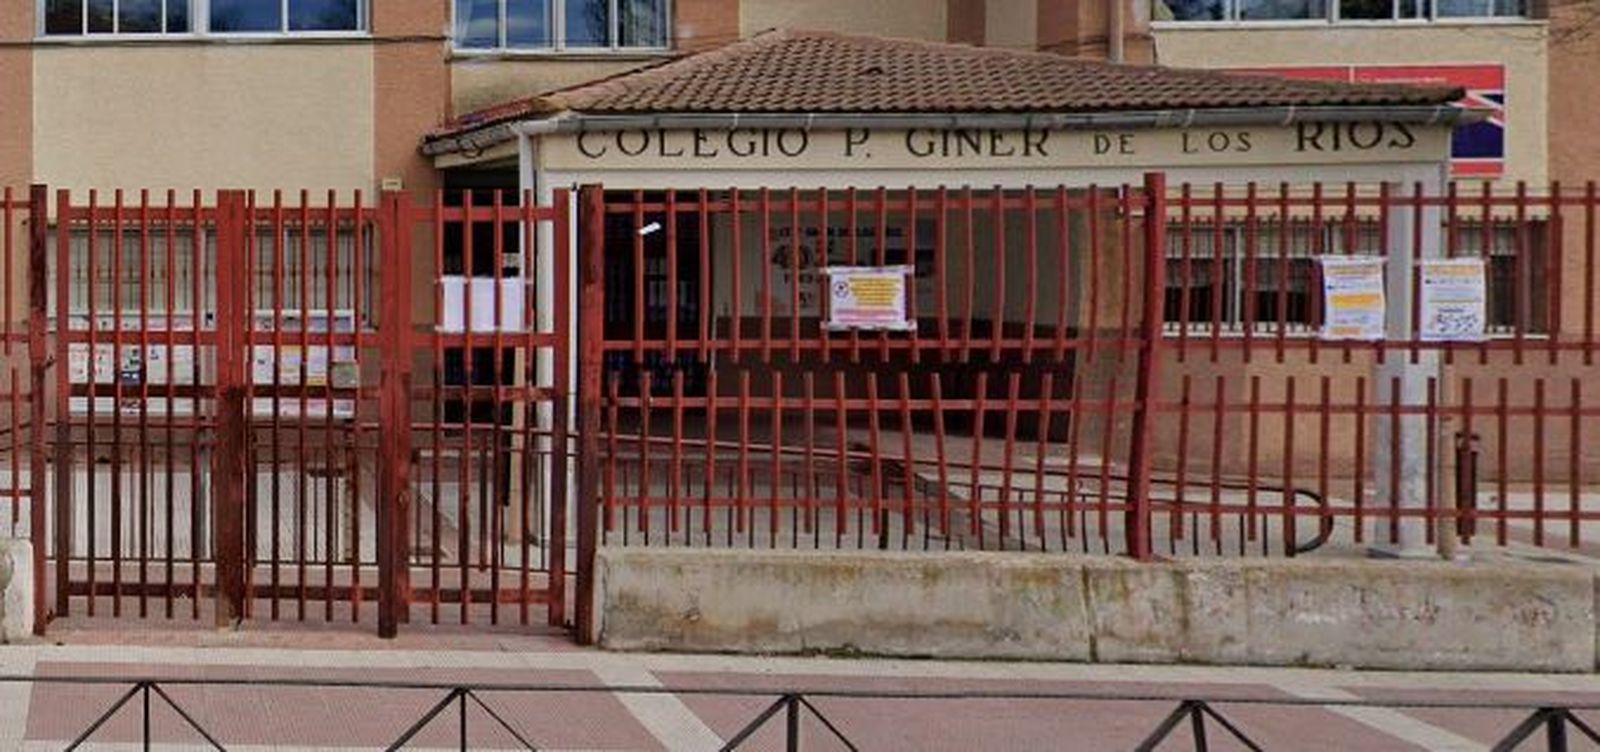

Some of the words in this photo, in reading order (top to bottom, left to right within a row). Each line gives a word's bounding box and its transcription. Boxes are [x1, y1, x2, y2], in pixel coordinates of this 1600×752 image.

[577, 127, 807, 157] COLEGIO
[844, 127, 871, 158] P.
[906, 126, 1048, 157] GINER
[1093, 133, 1135, 155] DE
[1182, 131, 1252, 154] LOS
[1295, 120, 1416, 151] RIOS
